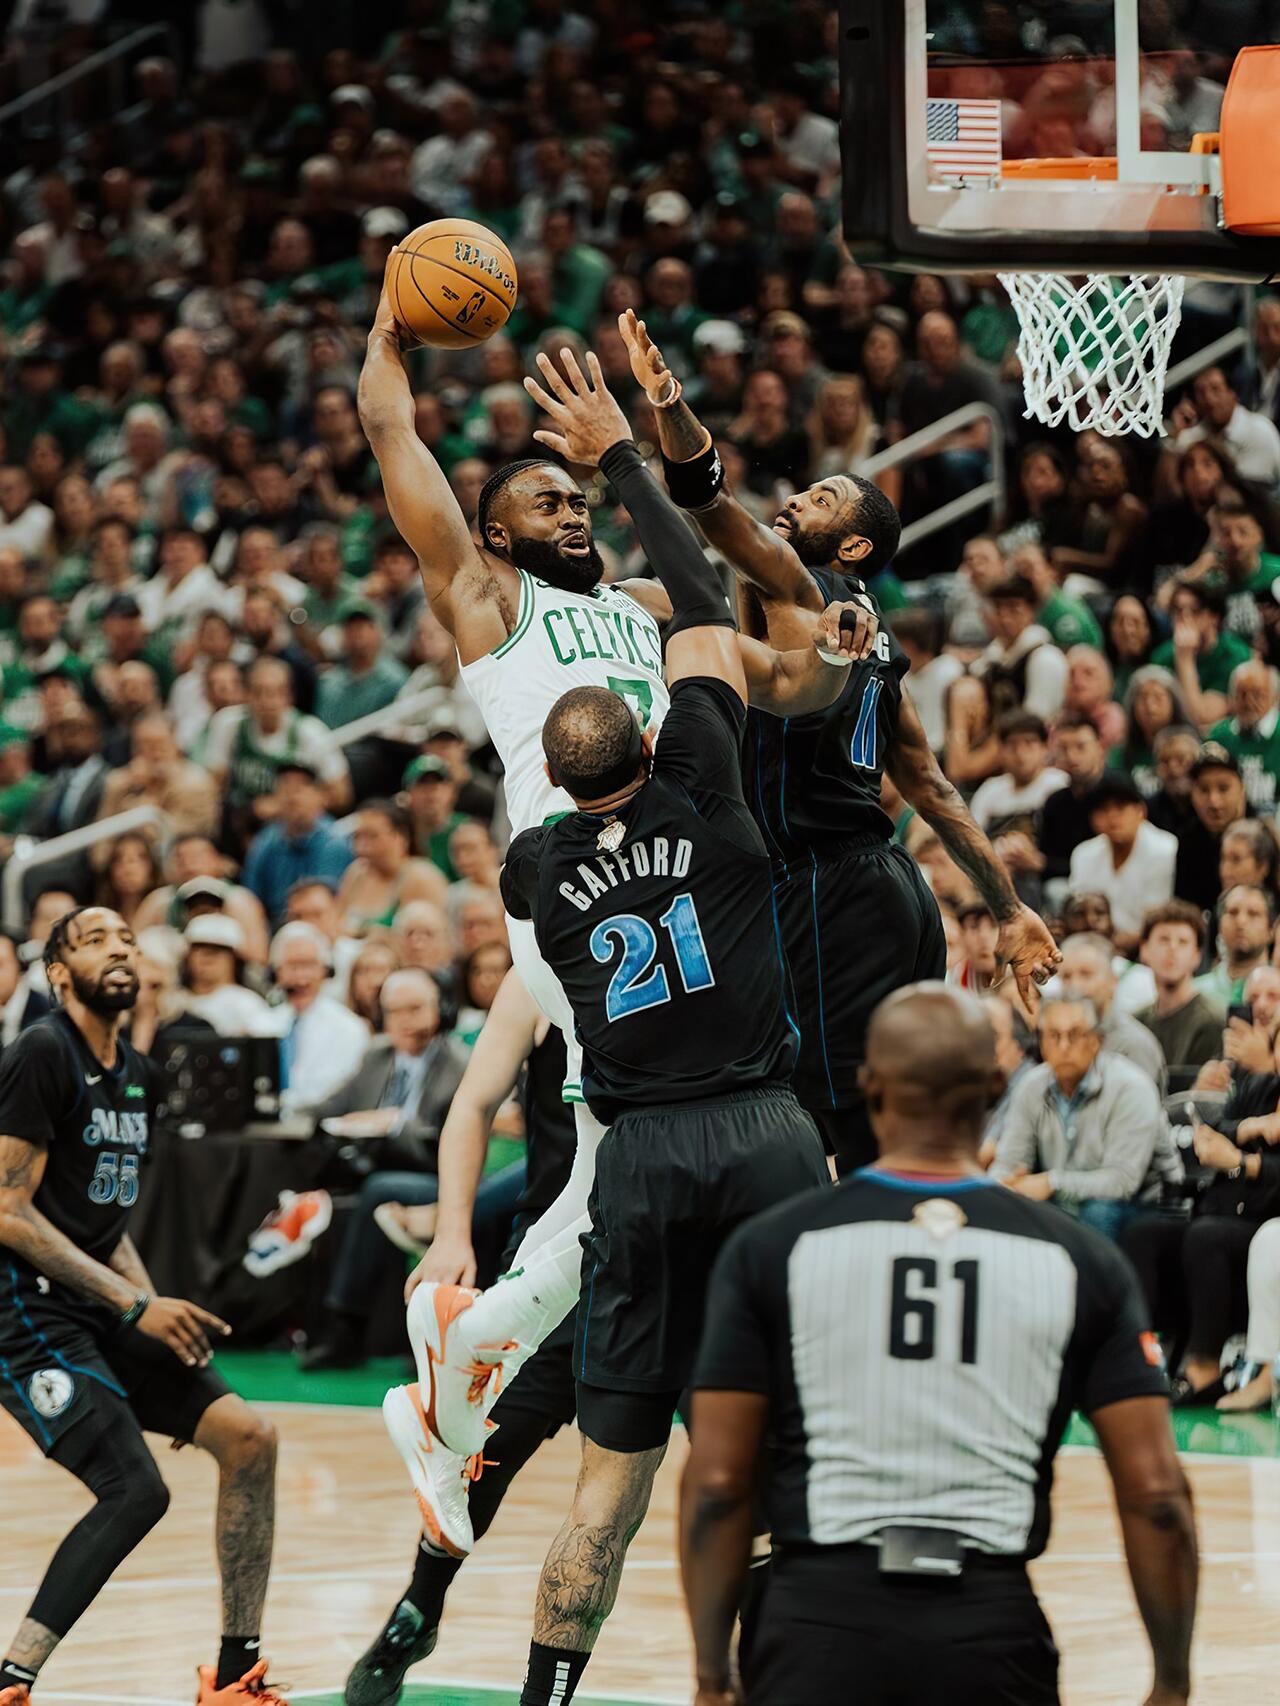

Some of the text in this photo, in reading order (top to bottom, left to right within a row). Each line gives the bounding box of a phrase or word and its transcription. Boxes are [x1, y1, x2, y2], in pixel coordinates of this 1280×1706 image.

[606, 675, 653, 729] 7
[851, 676, 884, 769] 11
[559, 837, 693, 912] GAFFORD
[589, 892, 715, 1023] 21
[88, 1151, 139, 1207] 55
[889, 1256, 979, 1364] 61
